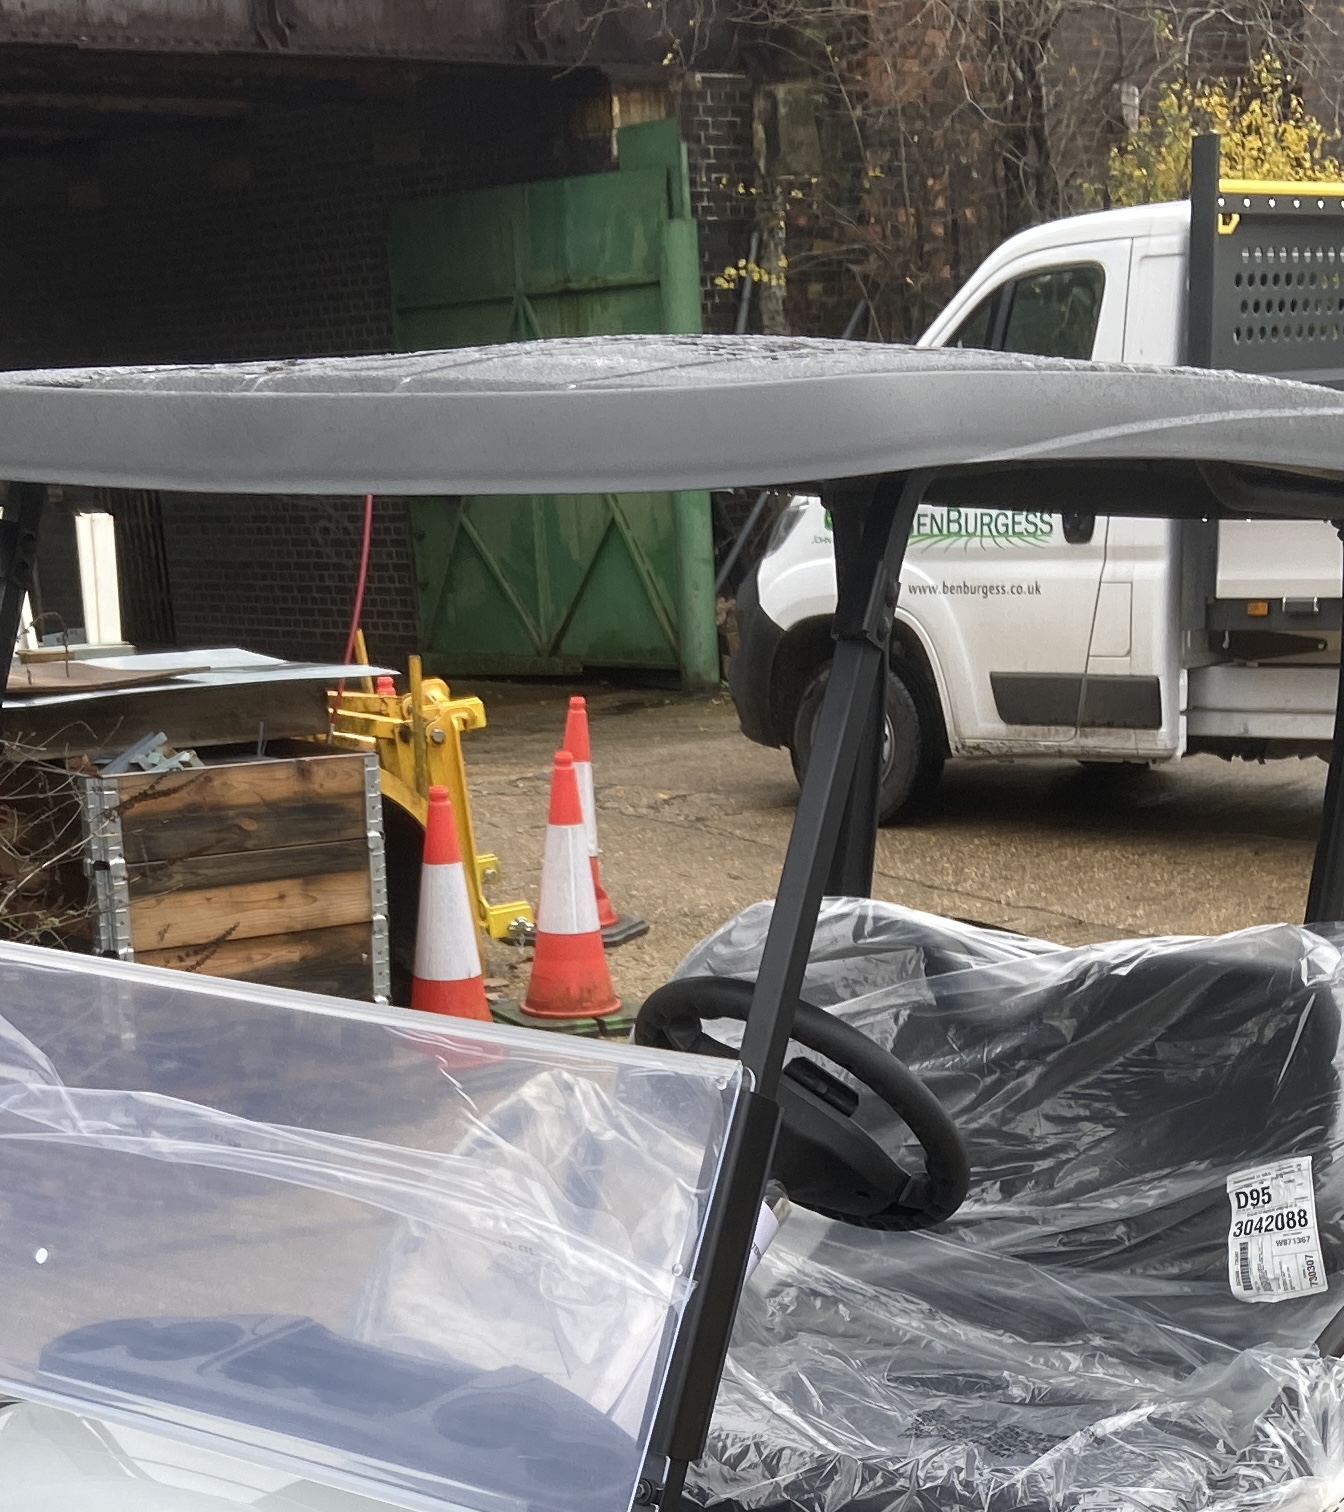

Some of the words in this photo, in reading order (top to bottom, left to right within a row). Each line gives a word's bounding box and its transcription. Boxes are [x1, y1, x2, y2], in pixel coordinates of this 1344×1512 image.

[911, 505, 1053, 536] ENBURGESS
[908, 580, 1042, 598] www.benburgess.co.uk
[1235, 1186, 1272, 1209] D95
[1233, 1209, 1309, 1237] 3042088
